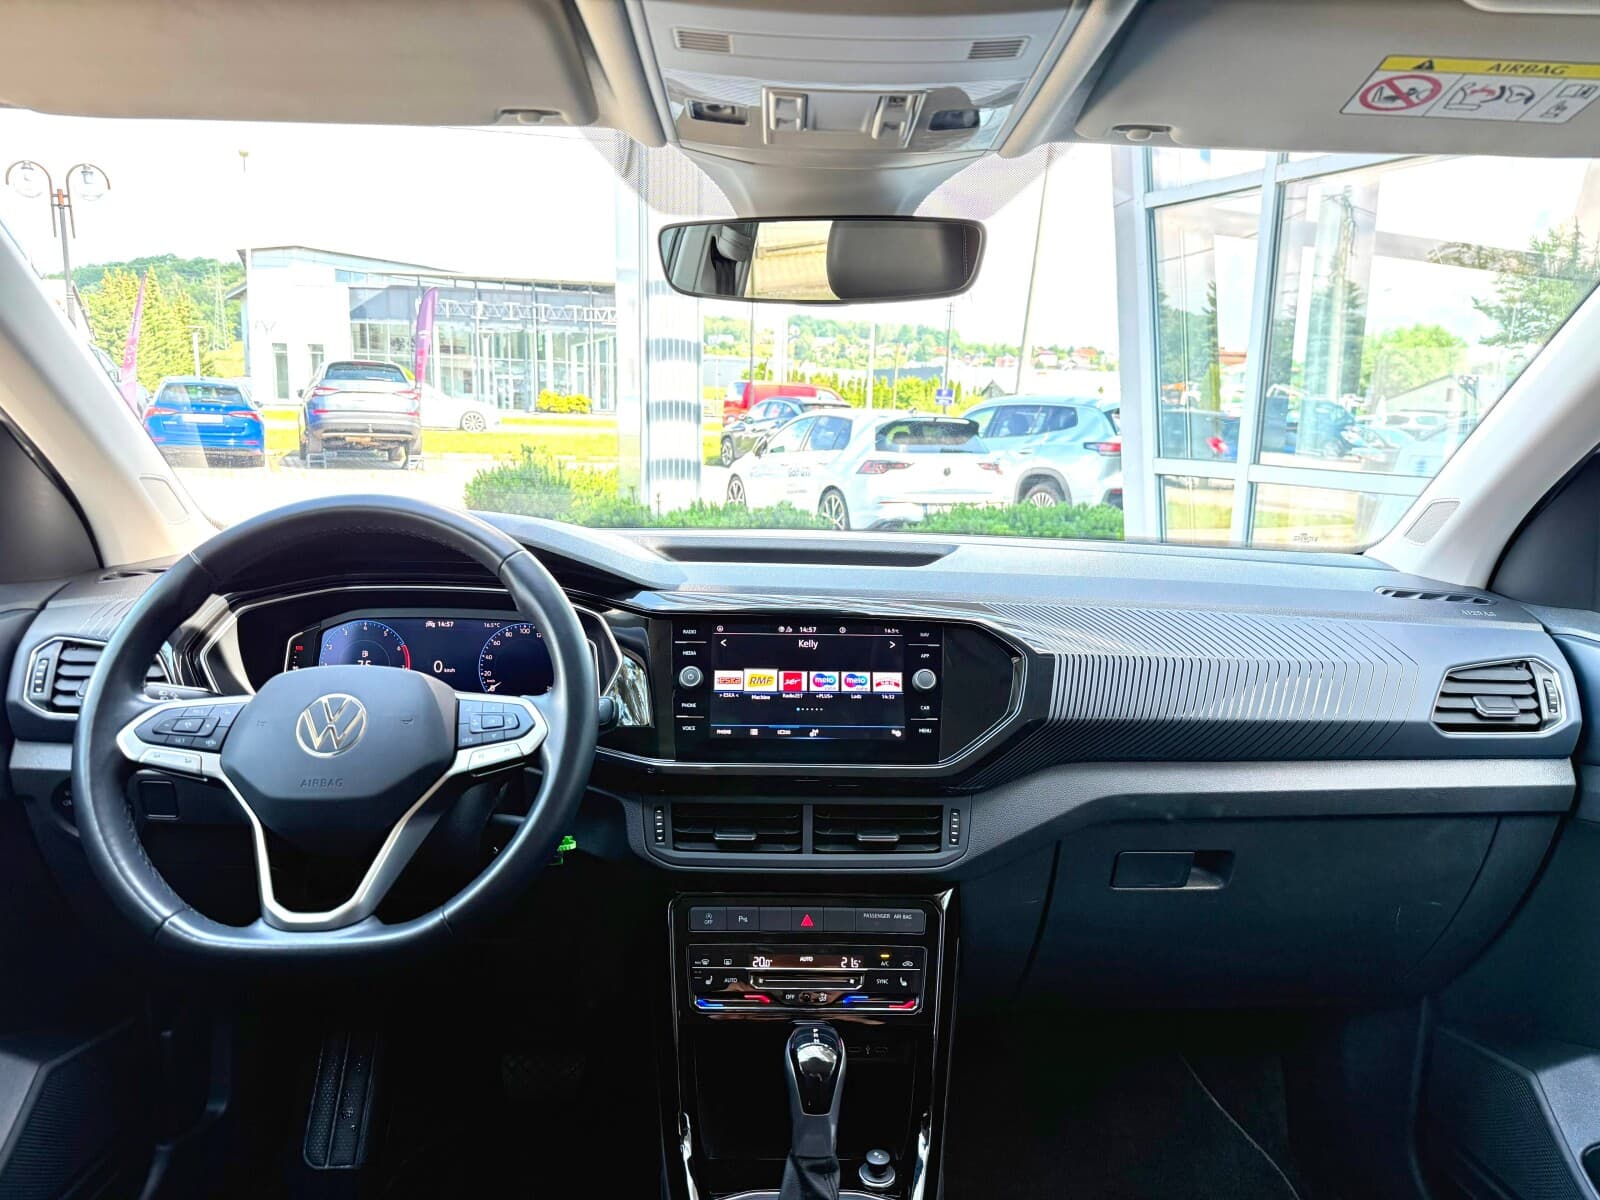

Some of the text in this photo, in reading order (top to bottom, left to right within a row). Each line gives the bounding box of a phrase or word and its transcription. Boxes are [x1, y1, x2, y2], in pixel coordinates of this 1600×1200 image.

[1487, 63, 1570, 76] AIRBAG
[798, 639, 819, 650] Kelly
[433, 660, 443, 673] 0
[749, 676, 774, 686] RMF
[300, 778, 344, 788] AIRBAG
